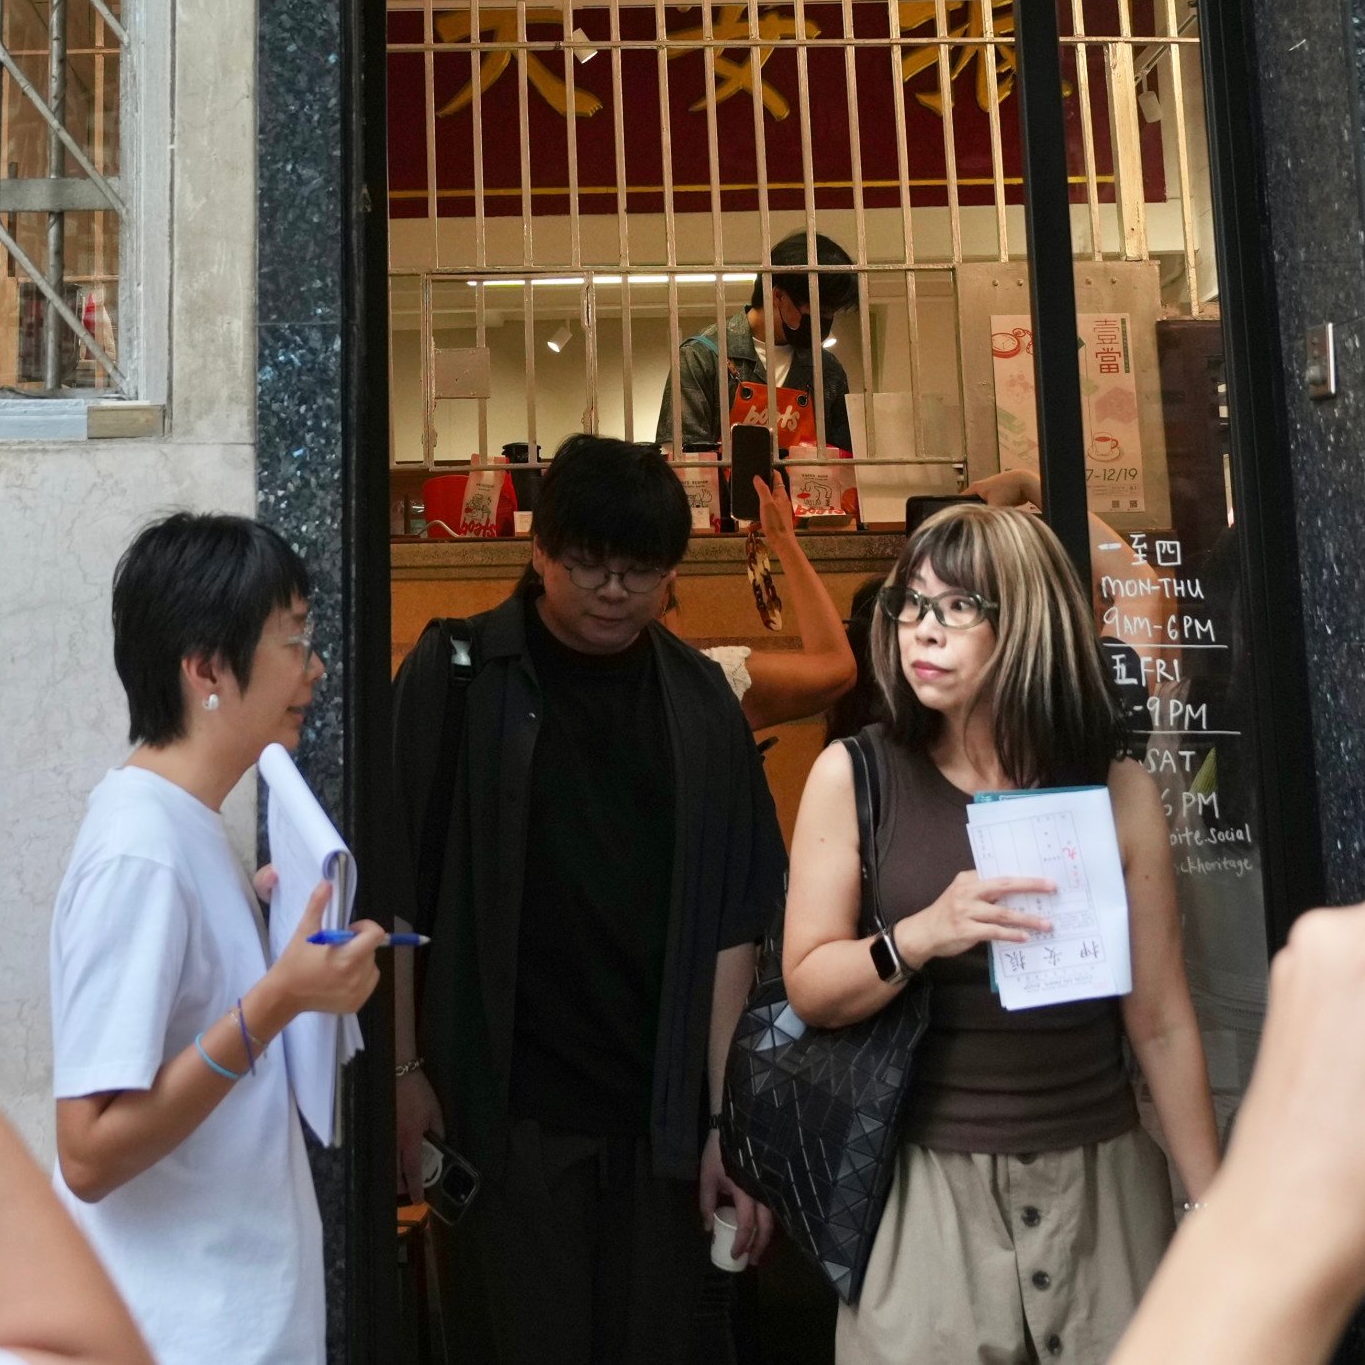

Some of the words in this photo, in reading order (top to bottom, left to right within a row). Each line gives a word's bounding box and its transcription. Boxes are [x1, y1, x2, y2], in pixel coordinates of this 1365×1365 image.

[1085, 467, 1138, 482] 7-12/19
[1097, 530, 1182, 566] 一至四
[1146, 748, 1196, 774] SAT
